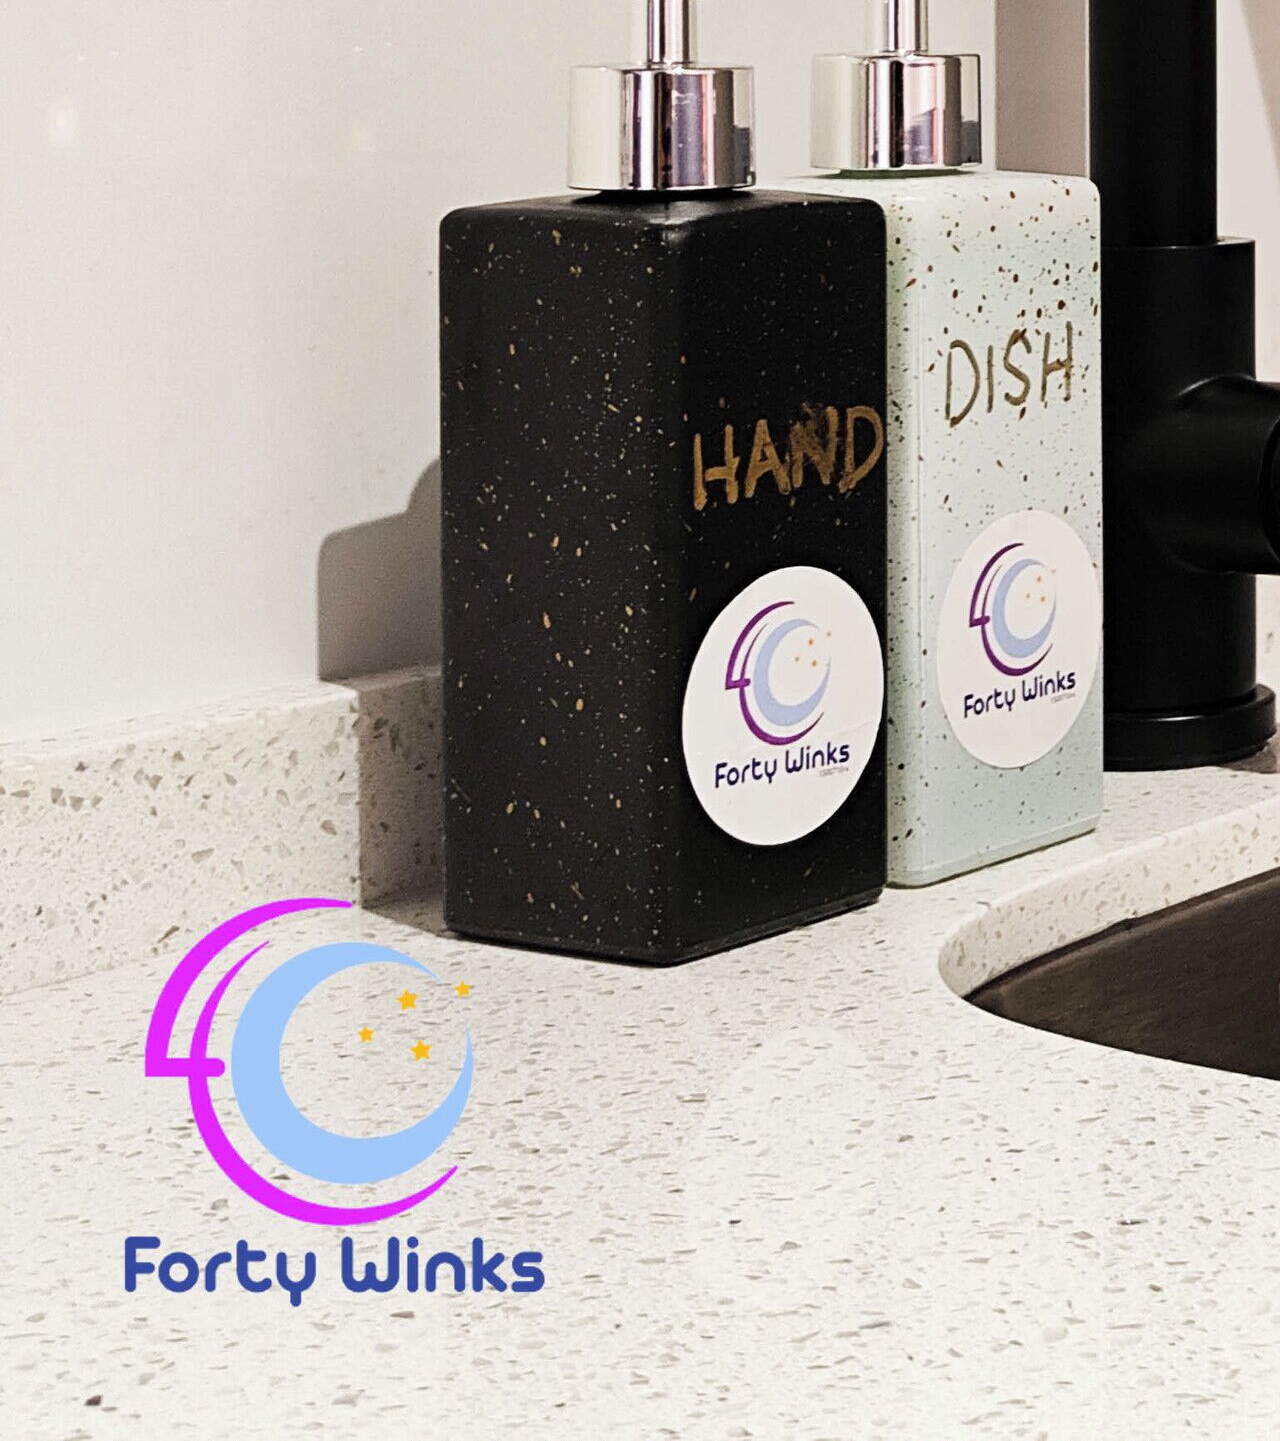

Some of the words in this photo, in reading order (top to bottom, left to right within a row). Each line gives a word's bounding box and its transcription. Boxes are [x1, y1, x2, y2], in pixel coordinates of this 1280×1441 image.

[944, 321, 1073, 427] DISH
[692, 402, 885, 511] HAND
[963, 687, 1016, 719] Forty
[1021, 670, 1076, 702] Winks
[714, 757, 777, 788] Forty
[785, 741, 850, 773] Winks
